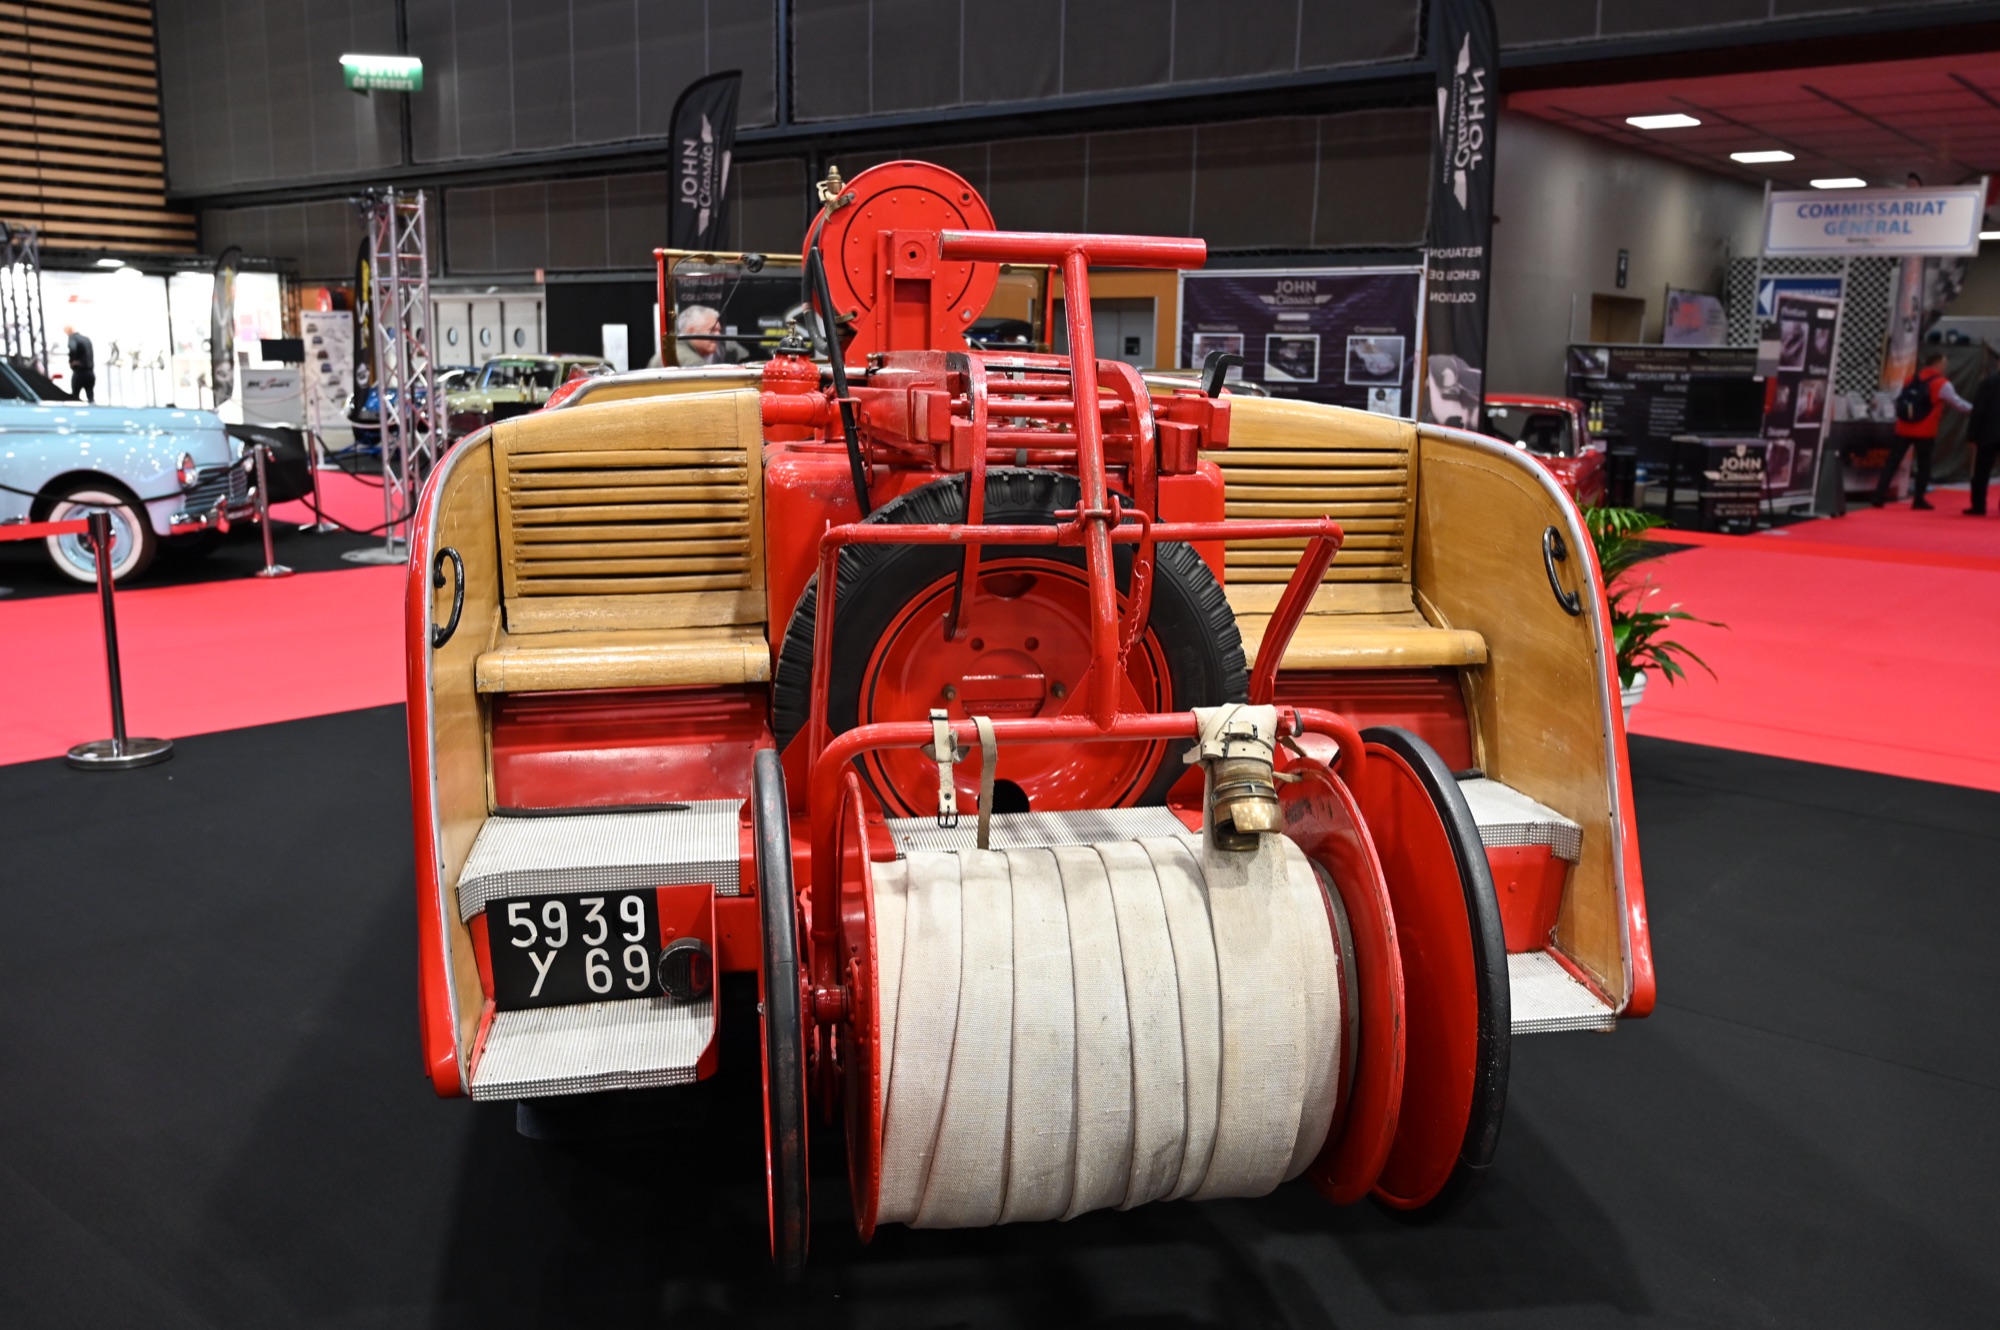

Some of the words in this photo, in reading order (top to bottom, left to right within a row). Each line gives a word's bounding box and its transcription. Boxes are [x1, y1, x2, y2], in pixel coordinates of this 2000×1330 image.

[681, 138, 698, 210] JOHN
[699, 145, 714, 208] Classic
[1797, 200, 1947, 219] COMMISSARIAT
[1824, 216, 1913, 236] GÉNÉRAL
[1274, 281, 1317, 294] JOHN
[1719, 457, 1761, 470] JOHN
[507, 895, 646, 948] 5939
[585, 944, 650, 994] 69
